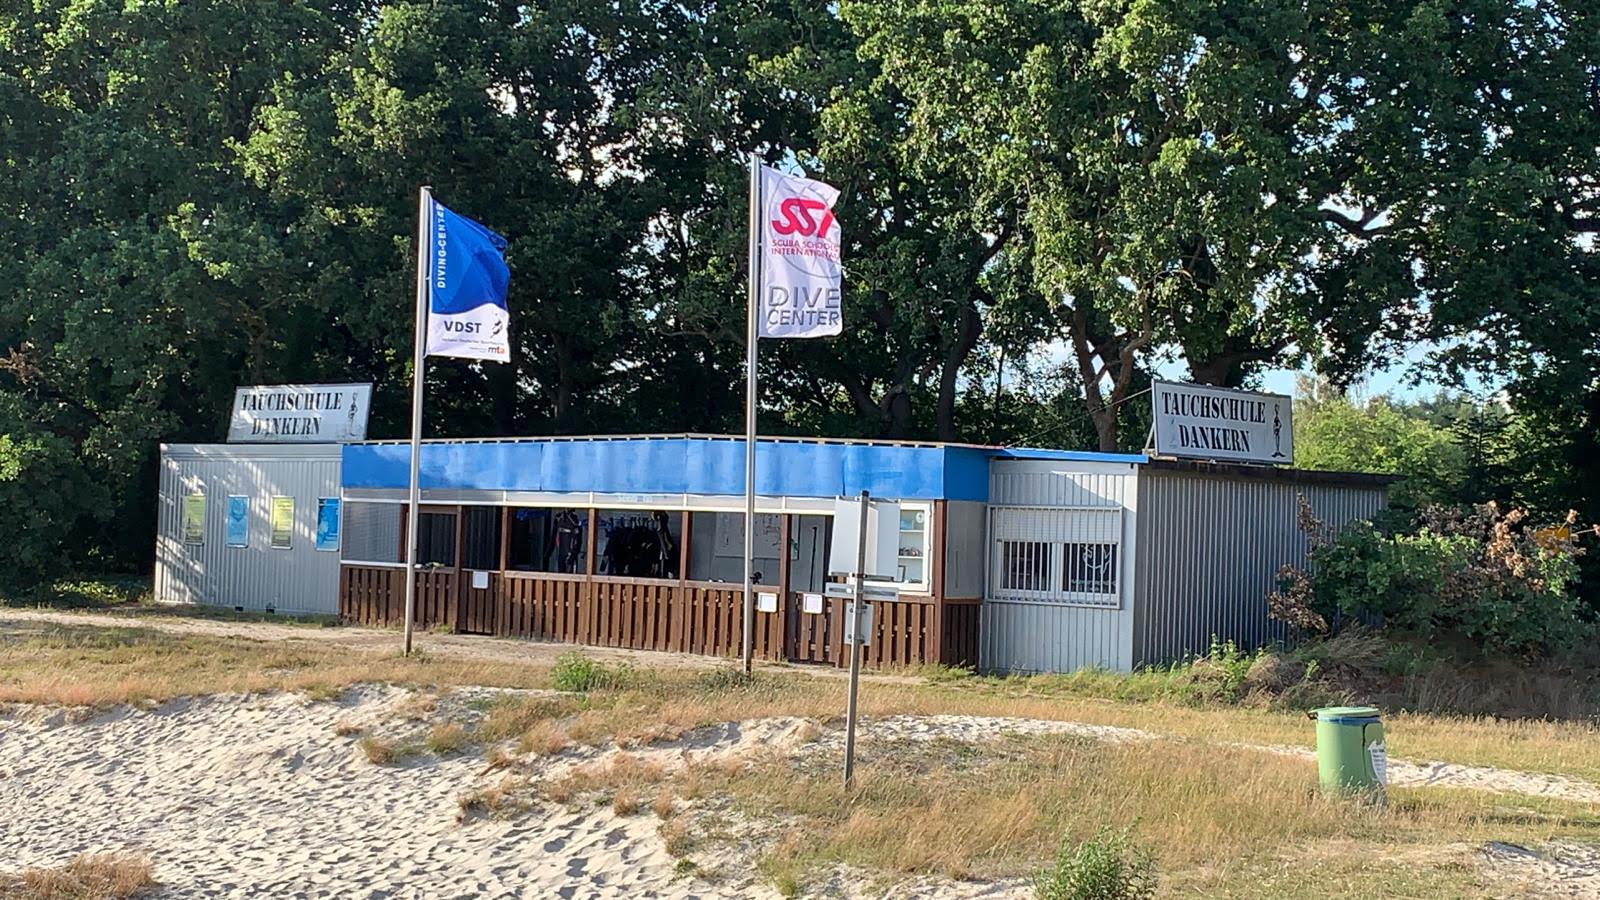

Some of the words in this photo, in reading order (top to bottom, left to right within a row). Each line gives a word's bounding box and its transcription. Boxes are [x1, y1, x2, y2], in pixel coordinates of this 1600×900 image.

[772, 198, 833, 238] SSI
[772, 239, 800, 248] SCUBA
[768, 286, 840, 308] DIVE
[444, 320, 482, 333] VDST
[768, 308, 840, 326] CENTER
[242, 392, 343, 411] TAUCHSCHULE
[1162, 391, 1266, 424] TAUCHSCHULE
[251, 417, 321, 436] DANKERN
[1179, 424, 1250, 453] DANKERN
